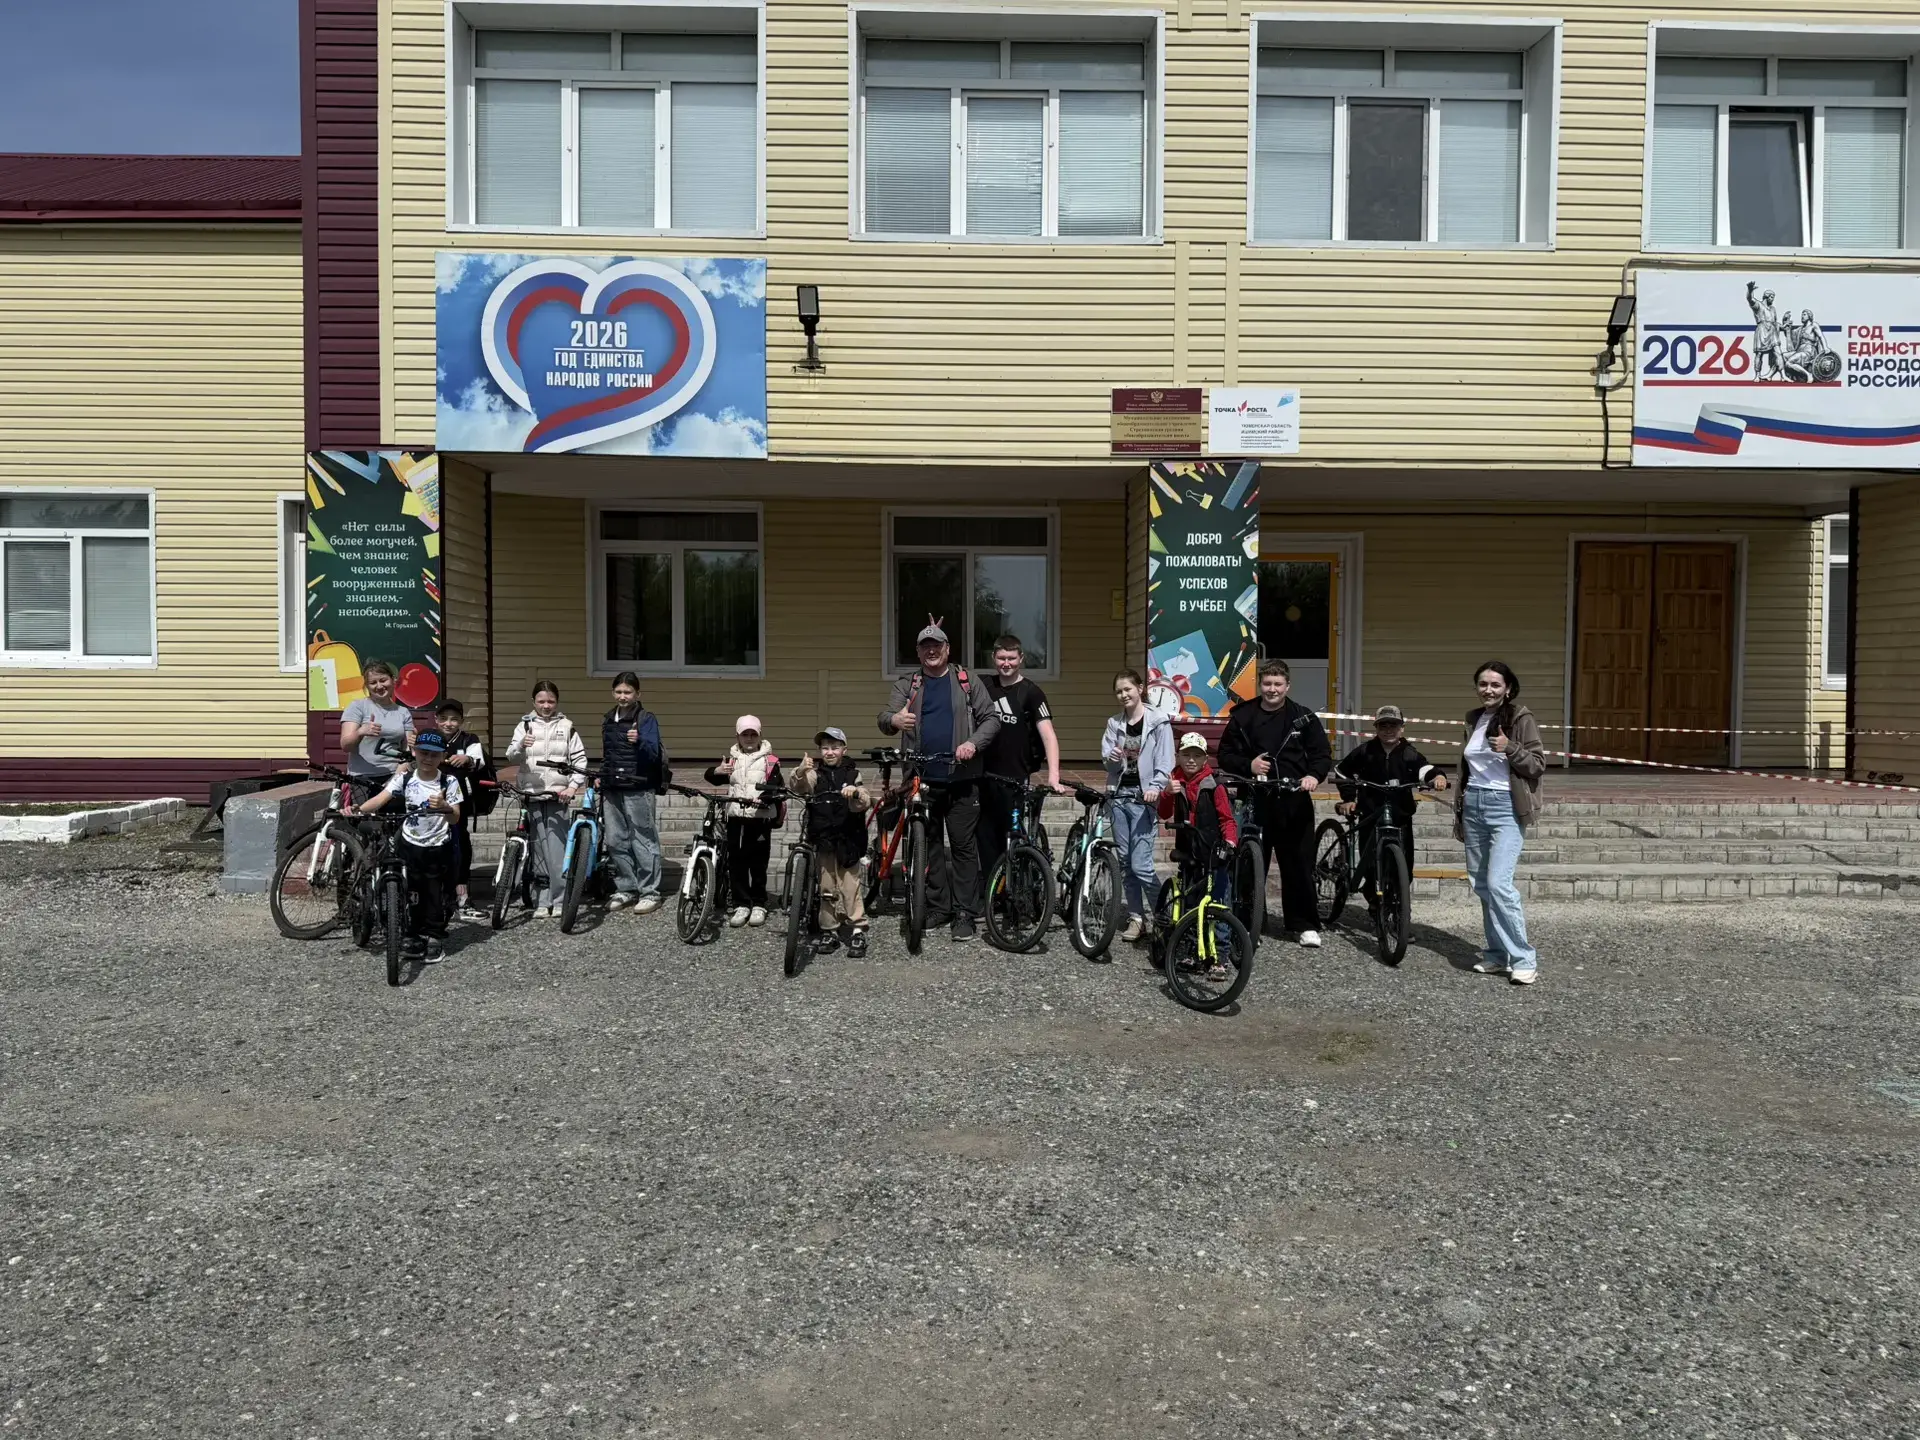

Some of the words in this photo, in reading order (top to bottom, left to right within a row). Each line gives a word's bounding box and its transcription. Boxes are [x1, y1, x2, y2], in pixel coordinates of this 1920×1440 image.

[570, 320, 628, 348] 2026
[1847, 325, 1884, 341] ГОД
[1642, 335, 1750, 375] 2026
[1847, 341, 1920, 357] ЕДИНСТ
[555, 352, 577, 368] ГОД
[583, 352, 644, 369] ЕДИНСТВА
[1847, 358, 1920, 374] НАРОДО
[546, 371, 600, 388] НАРОДОВ
[606, 373, 653, 388] РОССИИ
[1847, 374, 1920, 388] РОССИИ
[341, 521, 369, 532] «Нет
[374, 523, 406, 532] силы
[329, 535, 363, 546] более
[1185, 532, 1222, 545] ДОБРО
[338, 552, 361, 560] чем
[1165, 555, 1242, 568] ПОЖАЛОВАТЬ!
[350, 566, 398, 574] человек
[332, 579, 416, 591] вооруженный
[1179, 577, 1228, 590] УСПЕХОВ
[1179, 600, 1187, 612] В
[1189, 598, 1227, 612] УЧЁБЕ!
[338, 606, 411, 618] непобедим».
[416, 733, 442, 744] NEVER
